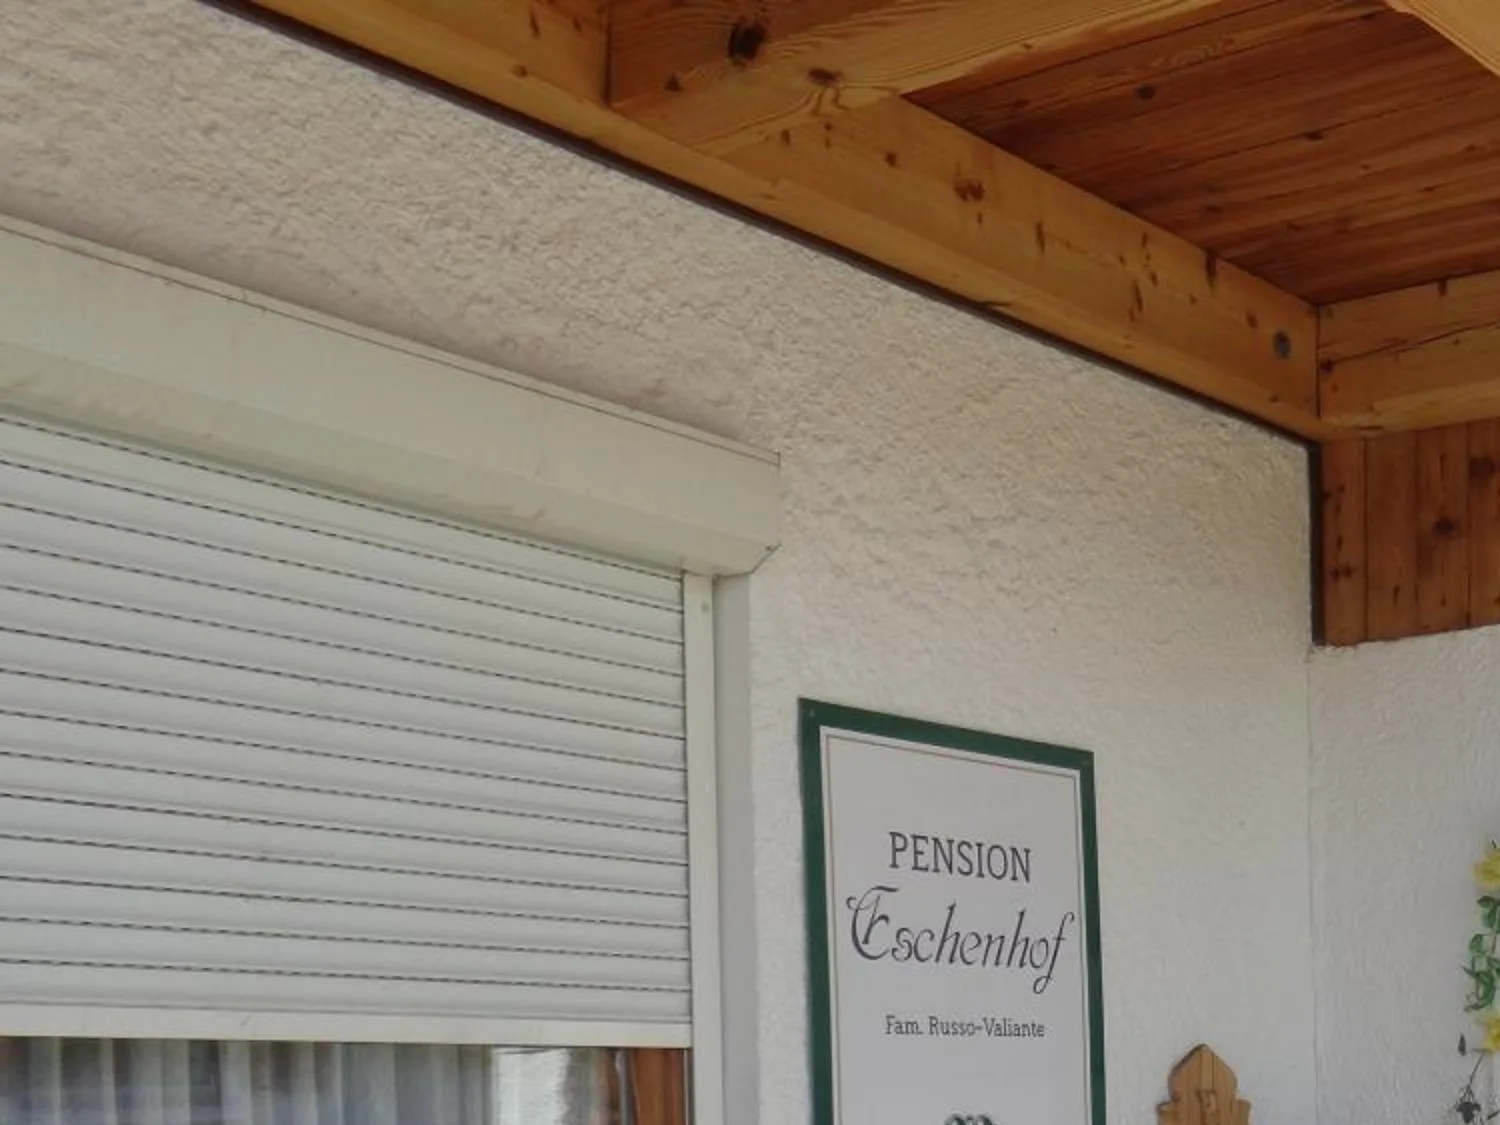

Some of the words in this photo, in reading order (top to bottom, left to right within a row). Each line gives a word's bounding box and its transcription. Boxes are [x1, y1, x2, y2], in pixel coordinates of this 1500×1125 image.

[888, 830, 1032, 883] PENSION
[845, 885, 1075, 995] Eschenhof
[884, 1014, 925, 1036] Fam.
[928, 1015, 1046, 1039] Russo-Valiante
